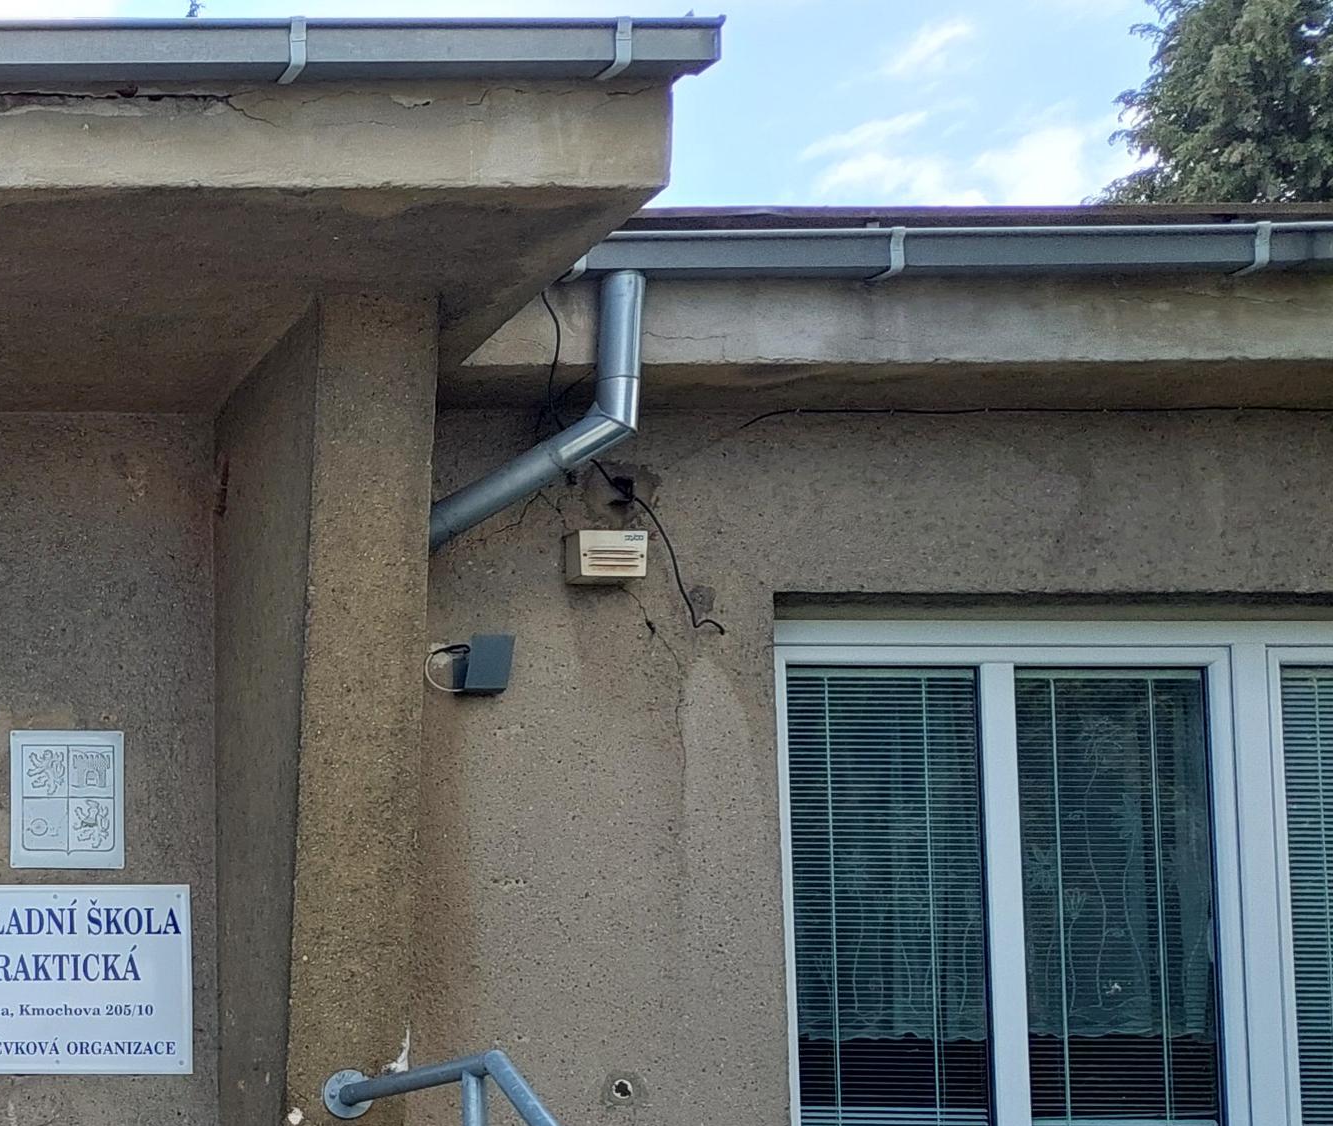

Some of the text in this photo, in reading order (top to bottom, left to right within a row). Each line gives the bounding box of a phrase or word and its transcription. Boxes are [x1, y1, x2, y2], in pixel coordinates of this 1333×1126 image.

[87, 899, 182, 935] ŠKOLA
[19, 1004, 101, 1017] Kmochova
[105, 1004, 154, 1017] 205/10
[66, 1041, 176, 1056] ORGANIZACE
